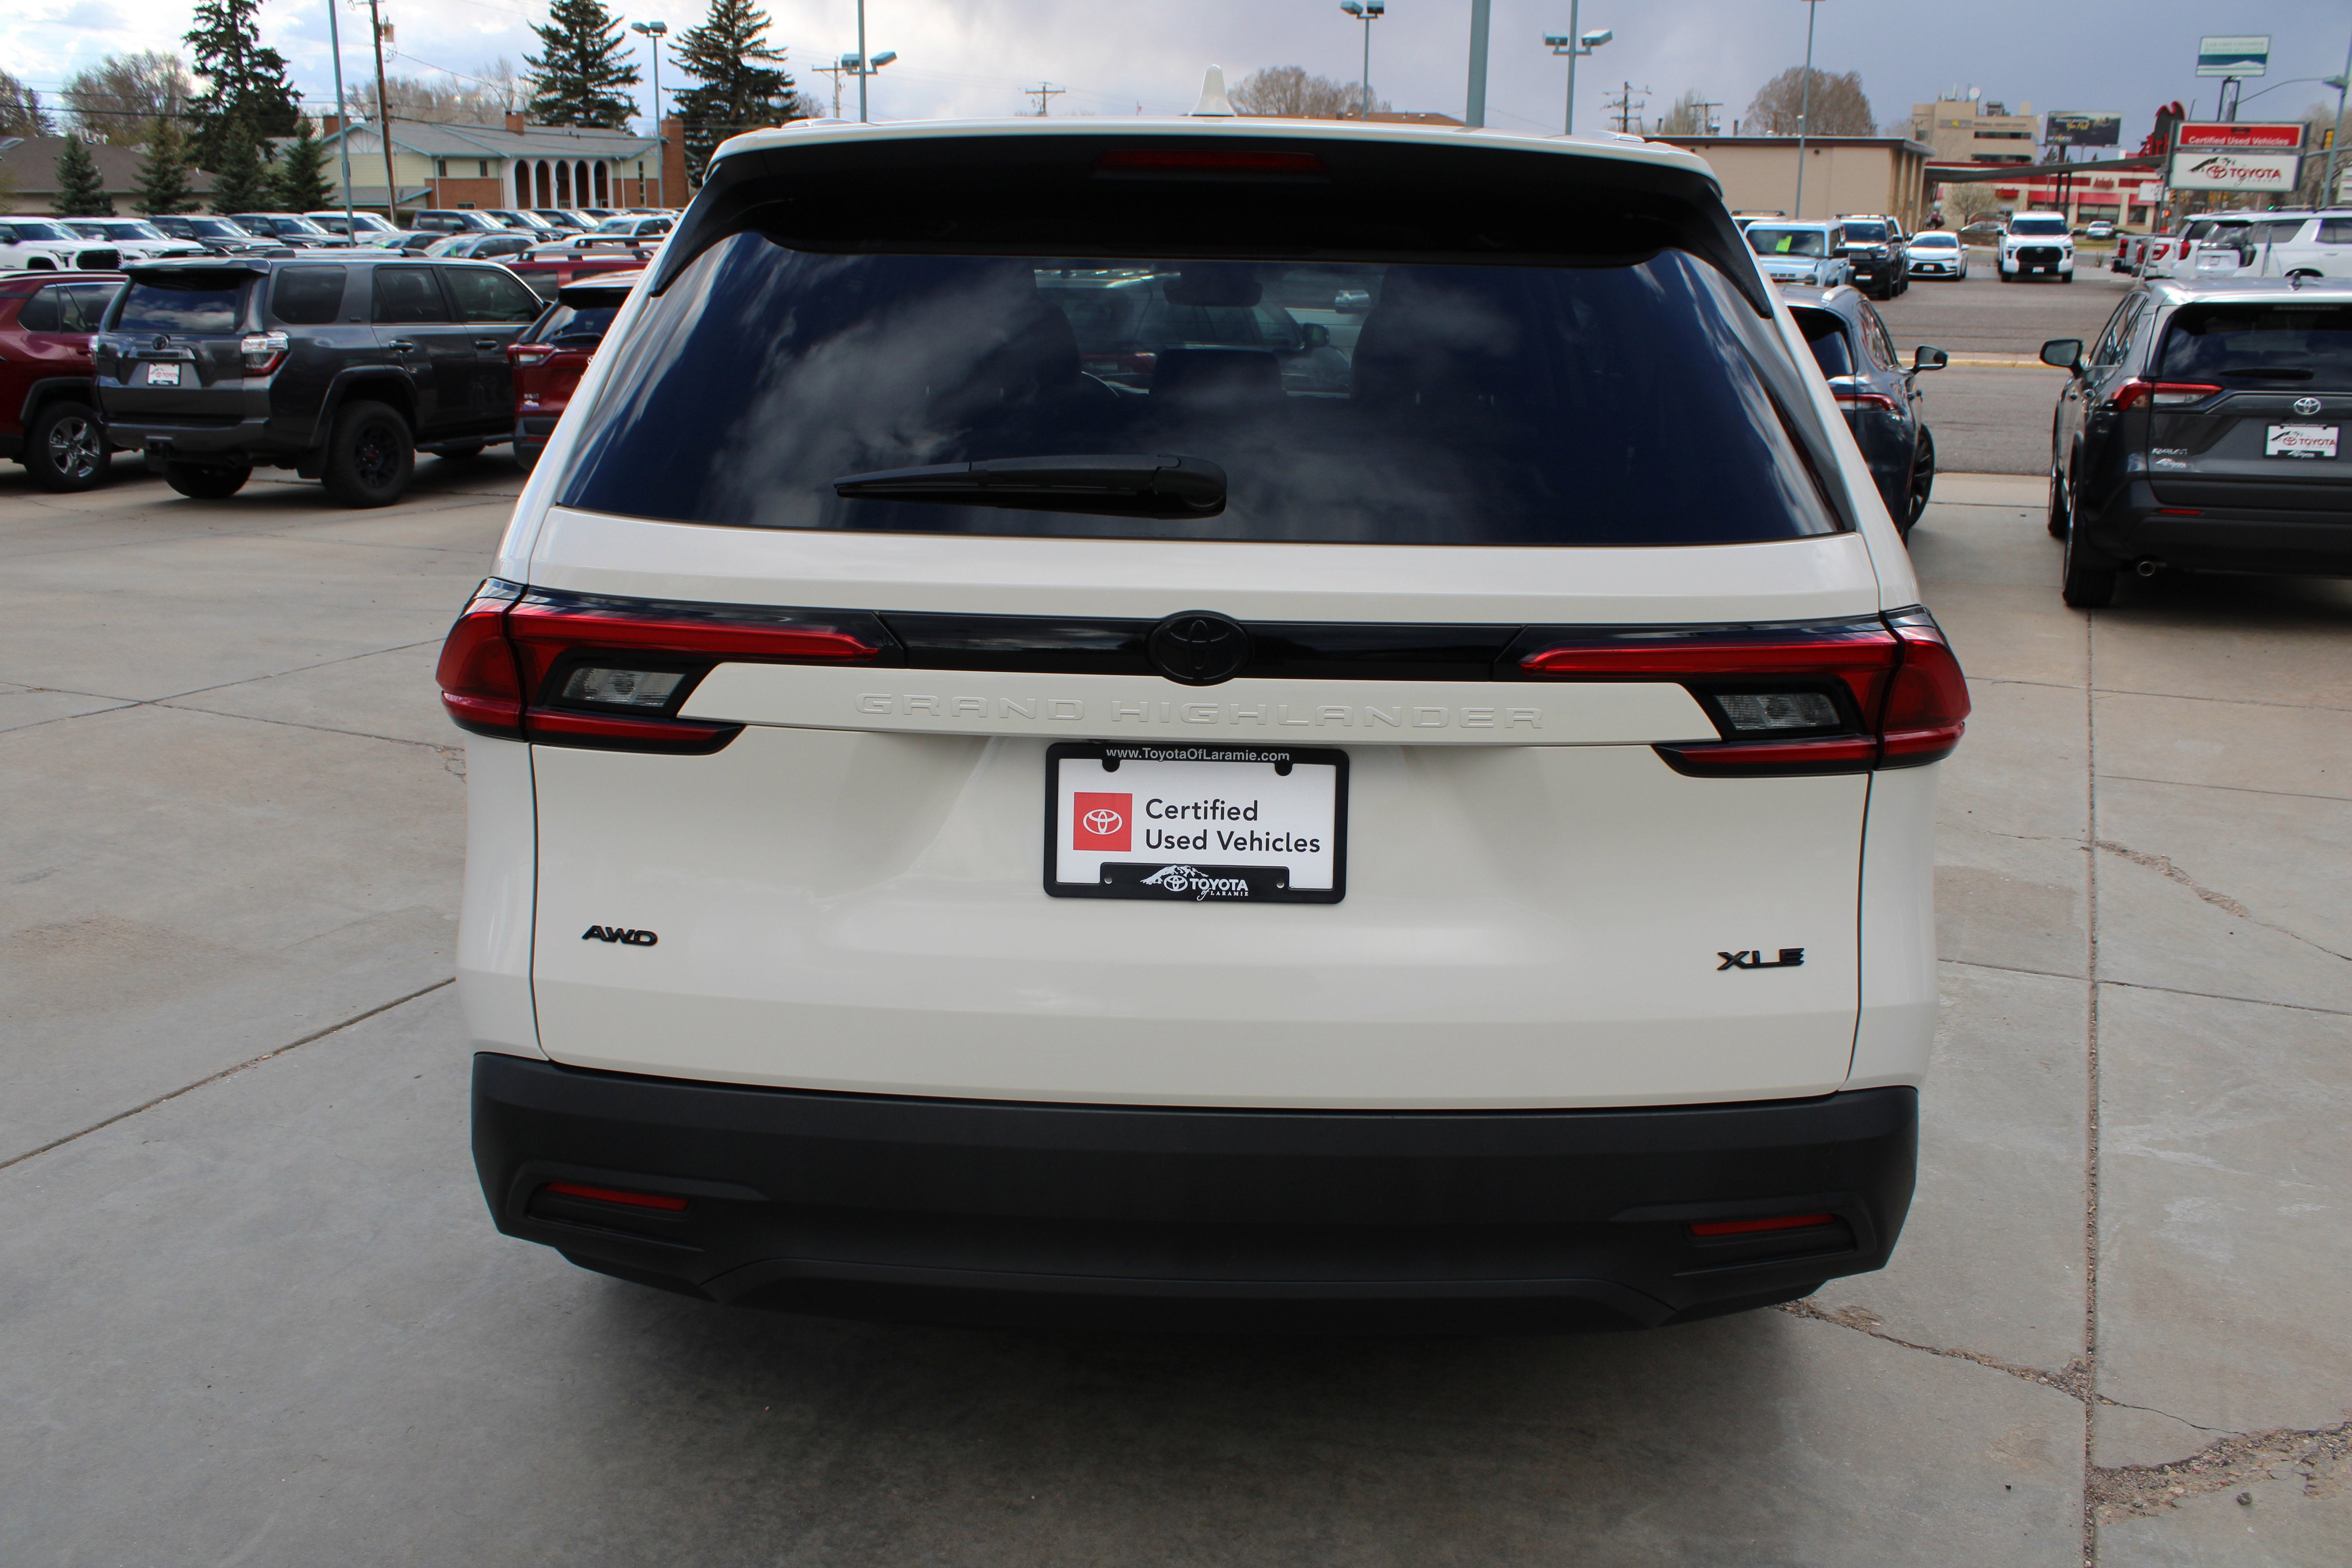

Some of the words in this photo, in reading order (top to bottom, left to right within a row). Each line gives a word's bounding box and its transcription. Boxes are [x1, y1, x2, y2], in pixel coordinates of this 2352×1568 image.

[2188, 136, 2226, 145] Certified
[2227, 136, 2251, 145] Used
[2252, 137, 2290, 145] Vehicles
[2230, 168, 2281, 178] TOYOTA
[855, 693, 1084, 720] GRAND
[1111, 701, 1542, 728] HIGHLANDER
[1106, 747, 1290, 762] www.ToyotaOfLaramie.com
[1145, 798, 1258, 821] Certified
[1146, 829, 1207, 850] Used
[1216, 830, 1320, 853] Vehicles
[1189, 878, 1249, 891] TOYOTA
[1196, 888, 1212, 901] of
[581, 925, 658, 947] AWD
[1717, 948, 1804, 970] XLE
